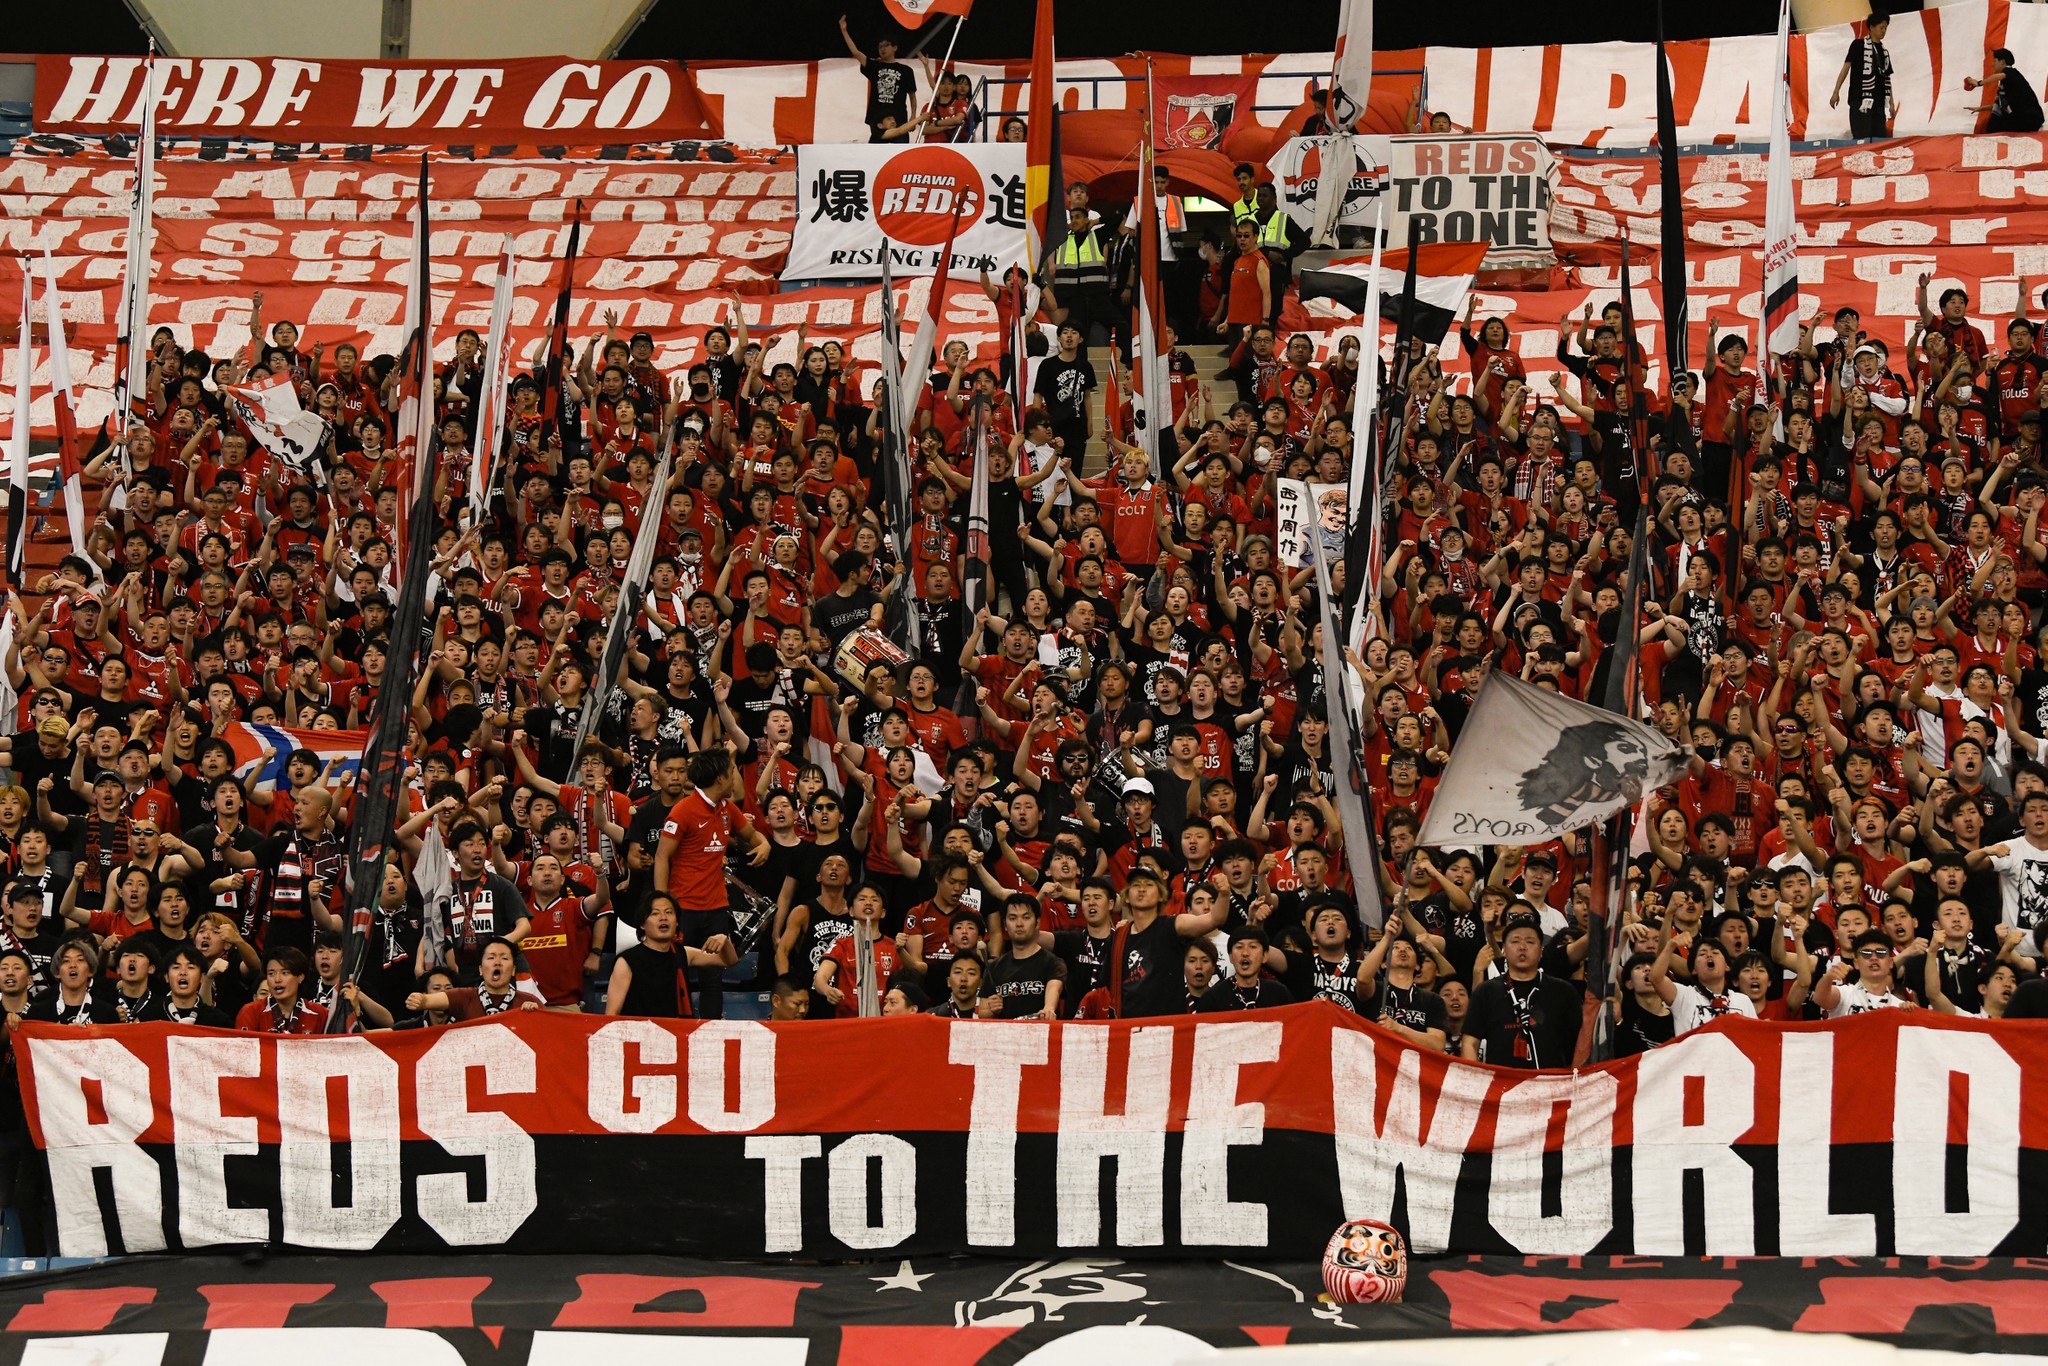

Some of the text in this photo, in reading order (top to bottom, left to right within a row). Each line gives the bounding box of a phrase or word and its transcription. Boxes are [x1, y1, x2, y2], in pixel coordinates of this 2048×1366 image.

[43, 56, 322, 128] HERE
[351, 67, 505, 130] WE
[521, 62, 672, 130] GO
[1414, 142, 1538, 175] REDS
[901, 173, 957, 187] URAWA
[811, 169, 869, 224] 爆
[879, 186, 979, 217] REDS
[1393, 176, 1453, 212] TO
[1409, 211, 1538, 247] BONE
[829, 248, 923, 270] RISING
[2001, 388, 2029, 400] POLUS
[1836, 467, 1846, 477] 19
[1117, 504, 1147, 517] COLT
[1279, 486, 1299, 558] 西川周作
[1041, 765, 1050, 780] 8
[813, 928, 830, 939] THE
[814, 920, 834, 932] REDS
[835, 921, 847, 930] GO
[522, 936, 560, 948] DHL
[27, 1019, 2022, 1258] REDS GO TO THE WORLD
[1355, 1279, 1379, 1301] 12
